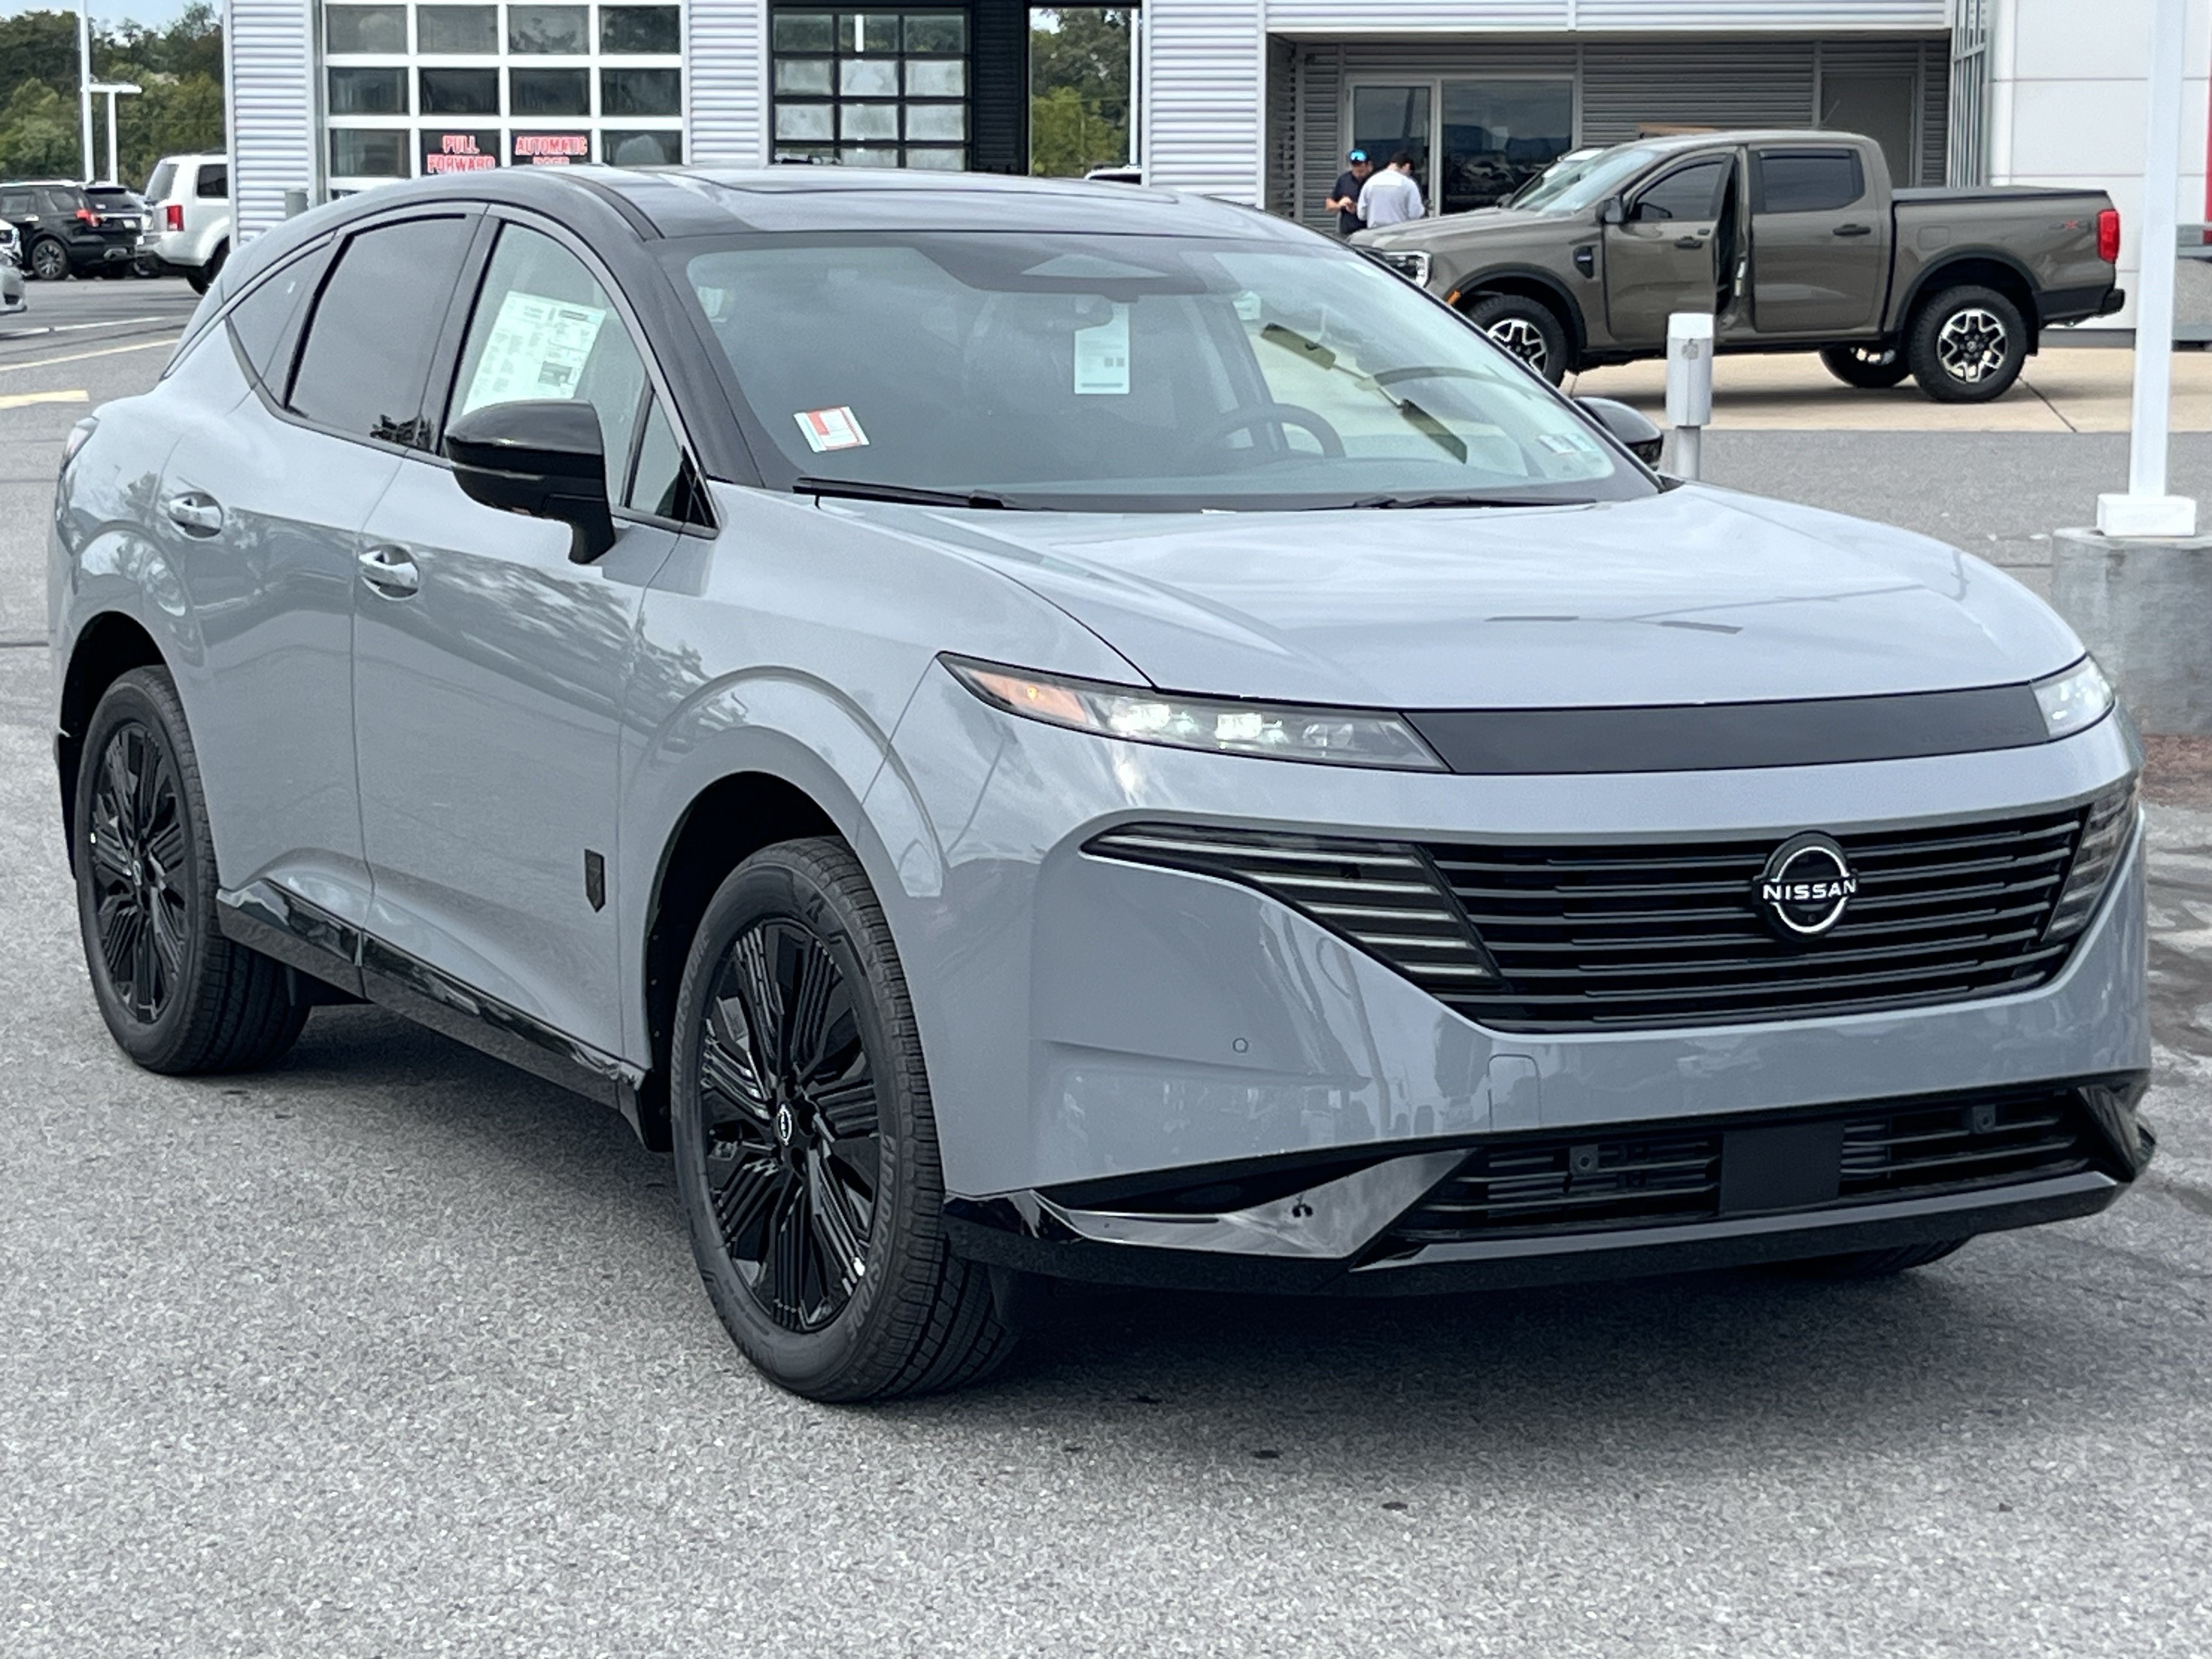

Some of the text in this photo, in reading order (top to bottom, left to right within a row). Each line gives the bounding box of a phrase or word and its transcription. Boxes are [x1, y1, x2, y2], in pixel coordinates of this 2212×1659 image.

[442, 135, 480, 154] PULL
[515, 136, 588, 156] AUTOMATIC
[427, 154, 495, 173] FORWARD
[1763, 879, 1857, 900] NISSAN
